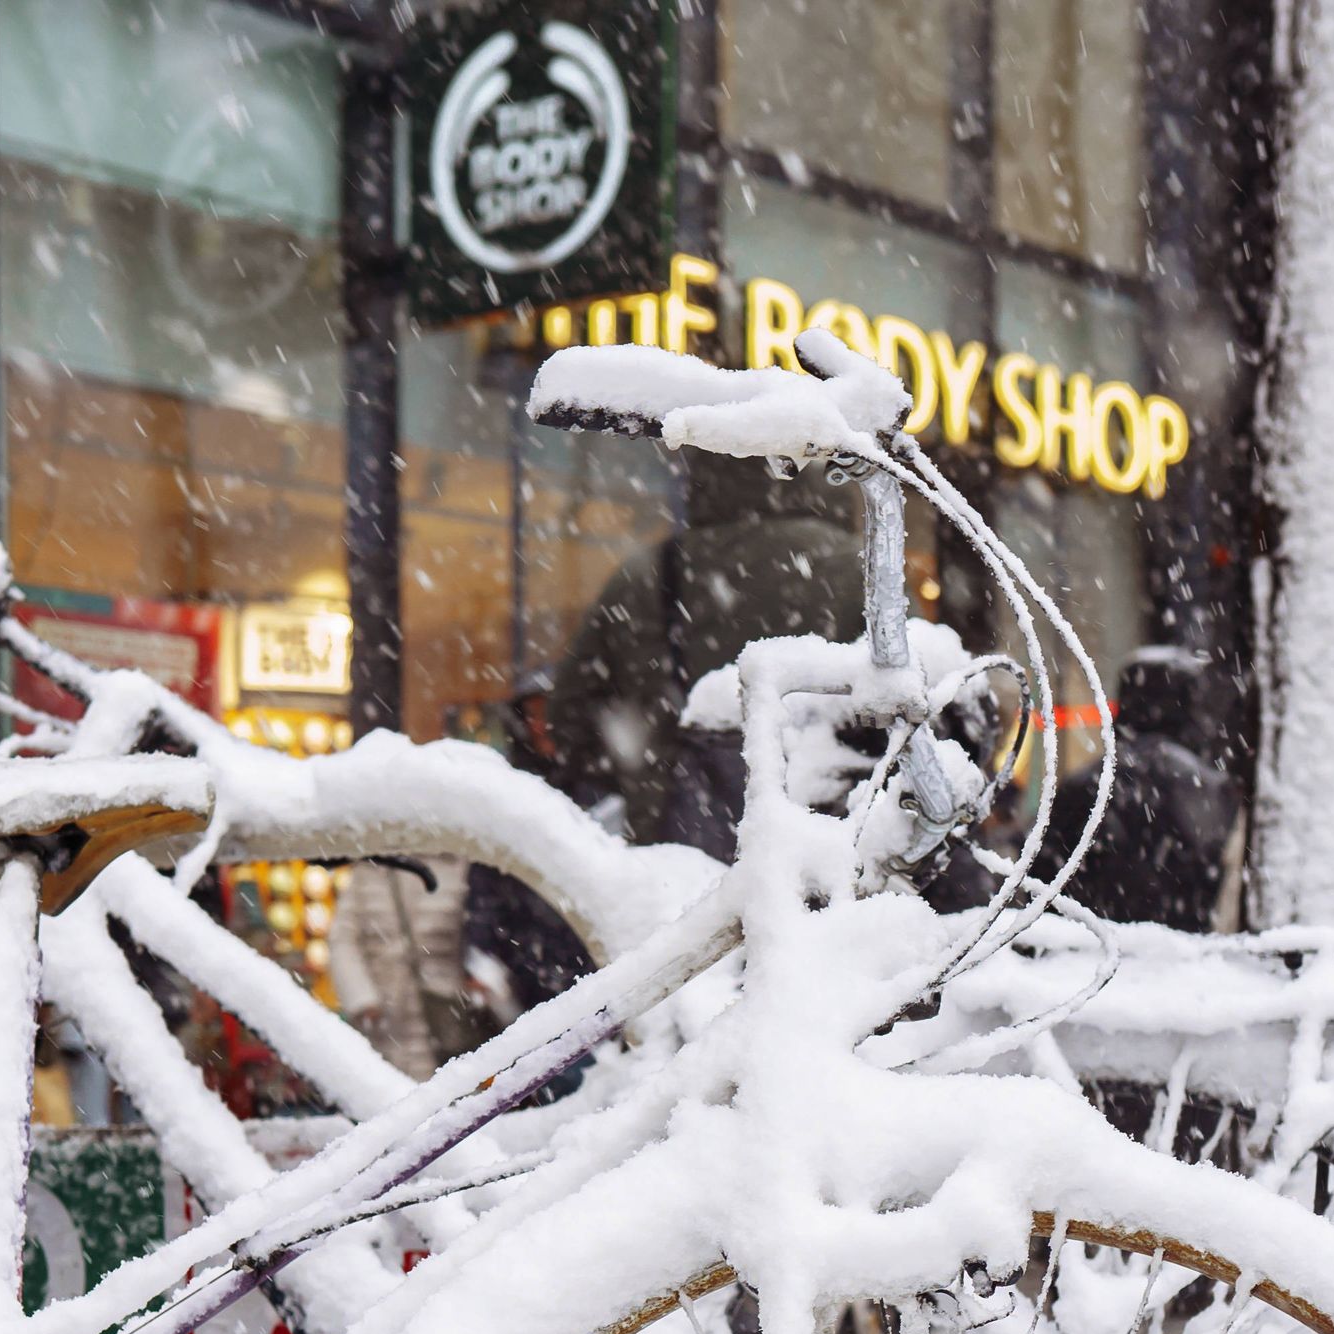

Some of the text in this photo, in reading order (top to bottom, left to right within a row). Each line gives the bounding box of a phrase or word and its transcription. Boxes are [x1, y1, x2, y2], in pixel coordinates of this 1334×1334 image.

[497, 94, 563, 140] THE
[470, 129, 592, 188] BODY
[476, 176, 586, 232] SHOP
[993, 352, 1189, 500] SHOP
